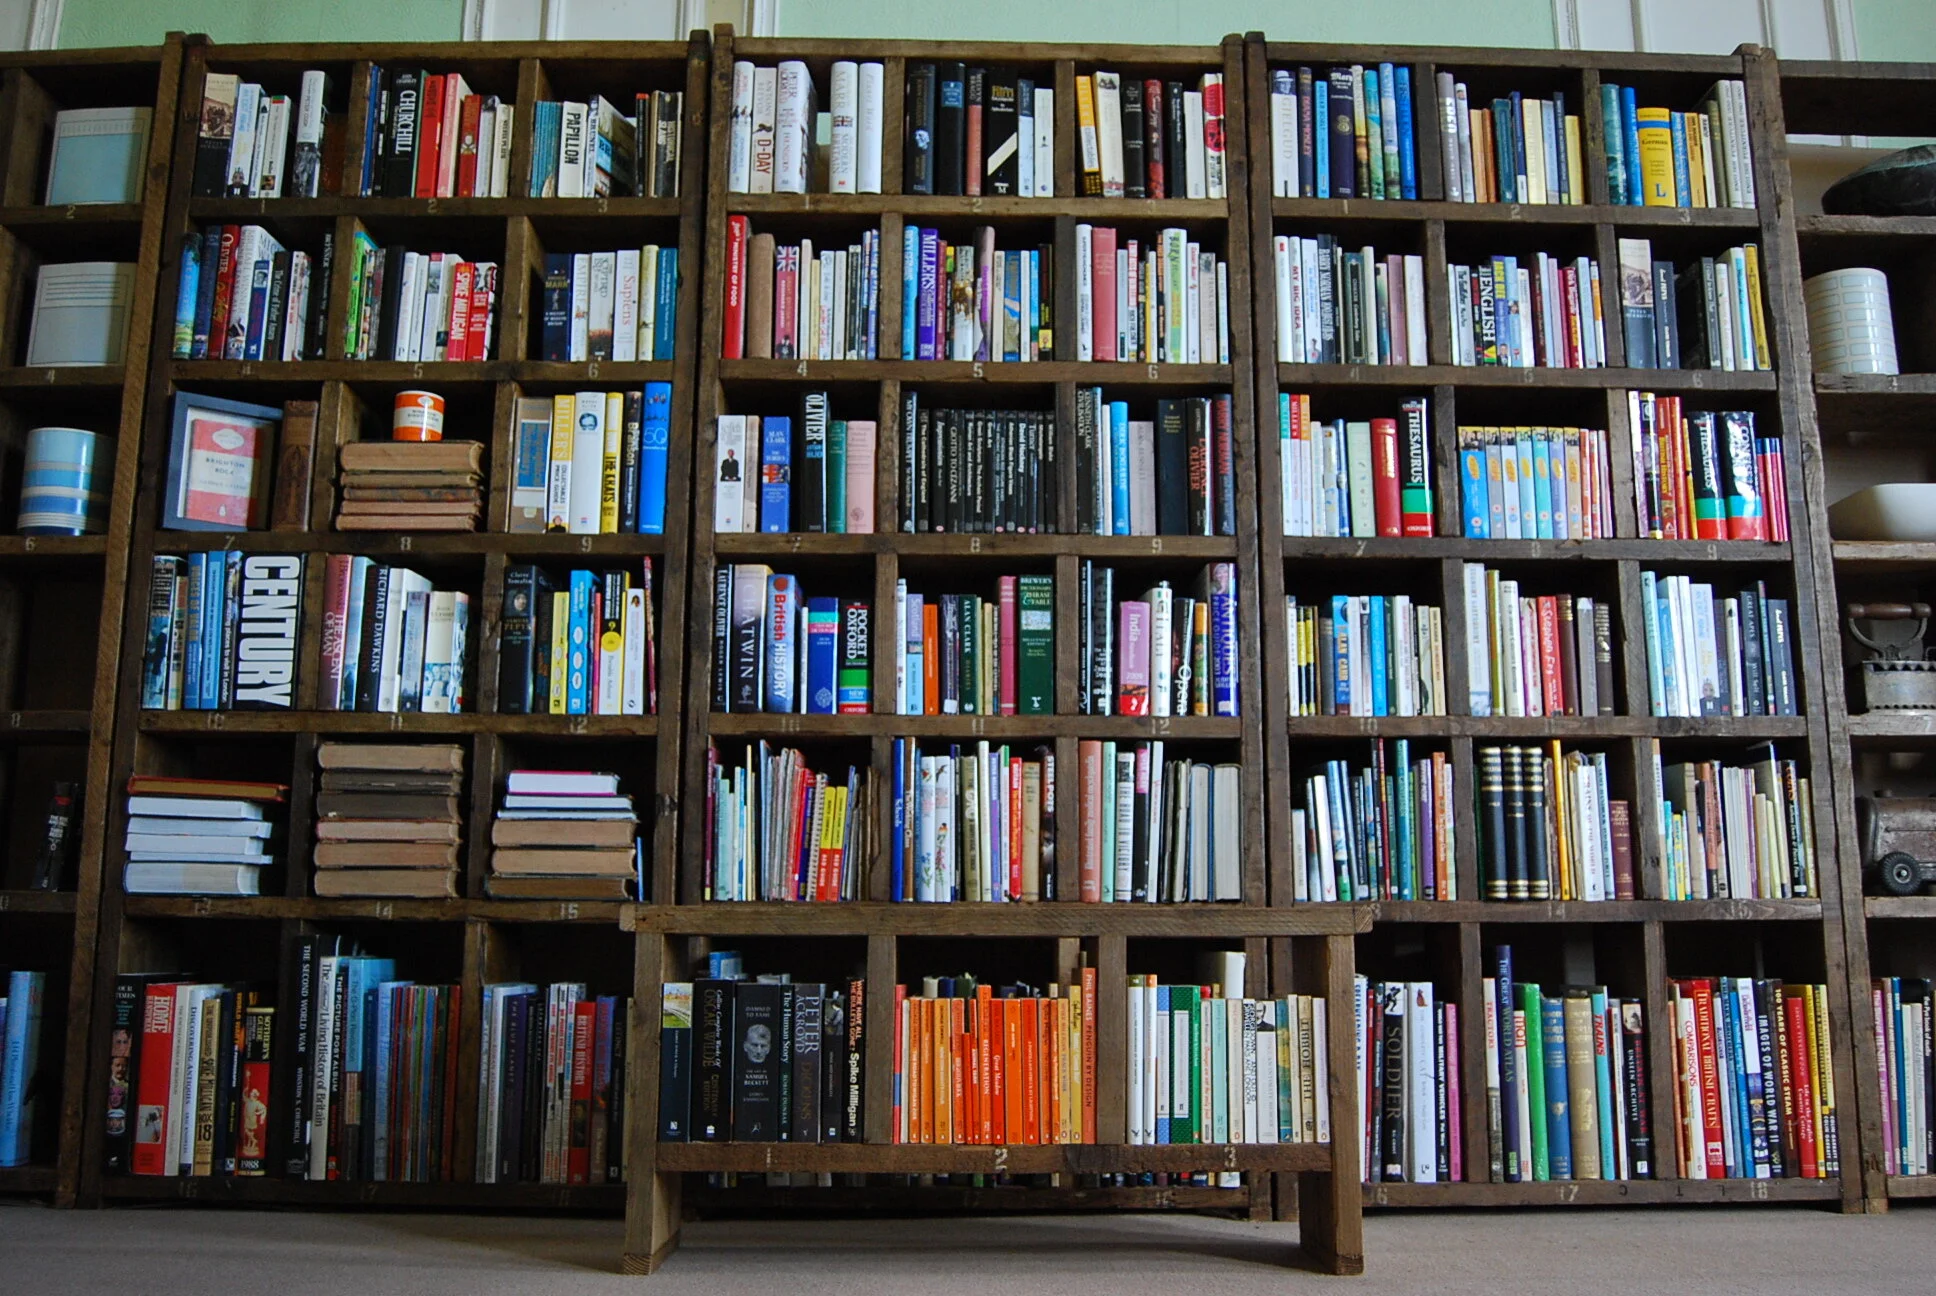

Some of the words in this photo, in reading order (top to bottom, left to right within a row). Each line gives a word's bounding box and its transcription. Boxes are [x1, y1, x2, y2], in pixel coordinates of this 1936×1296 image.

[395, 90, 416, 154] CHURCHILL
[565, 112, 580, 164] PAPILLON
[589, 118, 597, 153] BRUNEL
[1281, 97, 1294, 159] GIELGUD
[757, 139, 771, 174] D-DAY
[1656, 184, 1666, 197] L
[219, 234, 234, 273] OLIVIER
[456, 272, 470, 296] SPIKE
[1292, 266, 1299, 281] MY
[620, 275, 636, 326] Sapiens
[1459, 280, 1469, 305] Godfather
[1480, 277, 1496, 342] ENGLISH
[451, 298, 467, 340] MILLIGAN
[589, 363, 598, 377] 6
[558, 398, 569, 458] MILLER'S
[806, 394, 824, 441] OLIVIER
[1077, 391, 1085, 436] CIVILISATION
[626, 422, 639, 465] Branson
[1018, 423, 1026, 442] David
[1028, 424, 1037, 450] Turner
[1408, 411, 1422, 483] THESAURUS
[206, 457, 245, 468] BRIGHTON
[1017, 443, 1026, 473] Hockney
[1189, 446, 1200, 490] OLIVIER
[582, 537, 592, 552] 9
[971, 537, 980, 553] 8
[376, 568, 387, 619] RICHARD
[716, 569, 727, 607] LAURENCE
[236, 556, 300, 707] CENTURY
[325, 612, 334, 628] OF
[334, 614, 343, 635] THE
[716, 608, 726, 637] OLIVIER
[740, 584, 755, 678] CHATWIN
[774, 594, 786, 641] British
[847, 608, 857, 659] OXFORD
[857, 609, 867, 656] POCKET
[1129, 613, 1140, 641] India
[223, 627, 232, 648] places
[323, 628, 332, 656] MAN
[371, 623, 384, 673] DAWKINS
[964, 624, 972, 653] CLARK
[330, 636, 342, 680] ASCENT
[774, 643, 786, 699] HISTORY
[1175, 665, 1192, 713] Opera
[894, 798, 903, 827] Schools
[303, 944, 311, 961] THE
[301, 963, 310, 997] SECOND
[321, 963, 332, 980] The
[703, 988, 716, 1026] OSCAR
[783, 990, 791, 1007] The
[855, 980, 863, 1006] WHERE
[1774, 989, 1782, 1003] 100
[152, 996, 171, 1034] HOME
[299, 999, 309, 1030] WORLD
[317, 1013, 330, 1043] Living
[334, 994, 342, 1034] PICTURE
[782, 1008, 791, 1039] Human
[795, 994, 805, 1053] ACKROYD
[805, 995, 819, 1054] PETER
[1486, 1001, 1495, 1049] TRACTORS
[1502, 1006, 1511, 1047] WORLD
[1696, 991, 1713, 1052] TRADITIONAL
[1776, 1005, 1784, 1032] YEARS
[187, 1006, 197, 1062] DISCOVERING
[262, 1016, 271, 1060] SOTHEBY'S
[298, 1032, 307, 1053] WAR
[576, 1015, 588, 1049] BRITISH
[702, 1031, 715, 1067] WILDE
[1301, 1020, 1310, 1068] HOBBIT
[1594, 1014, 1605, 1056] TRAINS
[1758, 1014, 1771, 1053] IMAGES
[1779, 1035, 1786, 1046] OF
[202, 1058, 214, 1076] SPIKE
[316, 1044, 328, 1081] History
[508, 1048, 516, 1083] PLANET
[574, 1051, 587, 1086] HISTORY
[781, 1040, 790, 1063] Story
[849, 1053, 859, 1084] Spike
[1504, 1049, 1514, 1082] ATLAS
[1627, 1049, 1636, 1080] UNSEEN
[1685, 1020, 1696, 1087] COMPARISONS
[1762, 1055, 1772, 1067] OF
[1780, 1048, 1789, 1084] CLASSIC
[184, 1064, 194, 1105] ANTIQUES
[295, 1067, 303, 1098] WINSTON
[316, 1081, 326, 1092] of
[331, 1060, 339, 1092] ALBUM
[1303, 1074, 1311, 1102] THE
[1386, 1026, 1402, 1120] SOLDIER
[1703, 1055, 1716, 1090] BRITISH
[1763, 1070, 1776, 1107] WORLD
[199, 1079, 214, 1111] MILLIGAN
[799, 1061, 812, 1120] DICKENS
[847, 1085, 858, 1127] Milligan
[1630, 1083, 1638, 1121] ARCHIVES
[1783, 1086, 1792, 1115] STEAM
[293, 1107, 301, 1144] CHURCHILL
[315, 1093, 325, 1127] Britain
[1705, 1092, 1719, 1128] CRAFTS
[1766, 1109, 1778, 1127] WAR
[197, 1125, 212, 1142] 18
[1769, 1129, 1780, 1143] II
[1804, 1119, 1813, 1143] English
[240, 1160, 259, 1169] 1988
